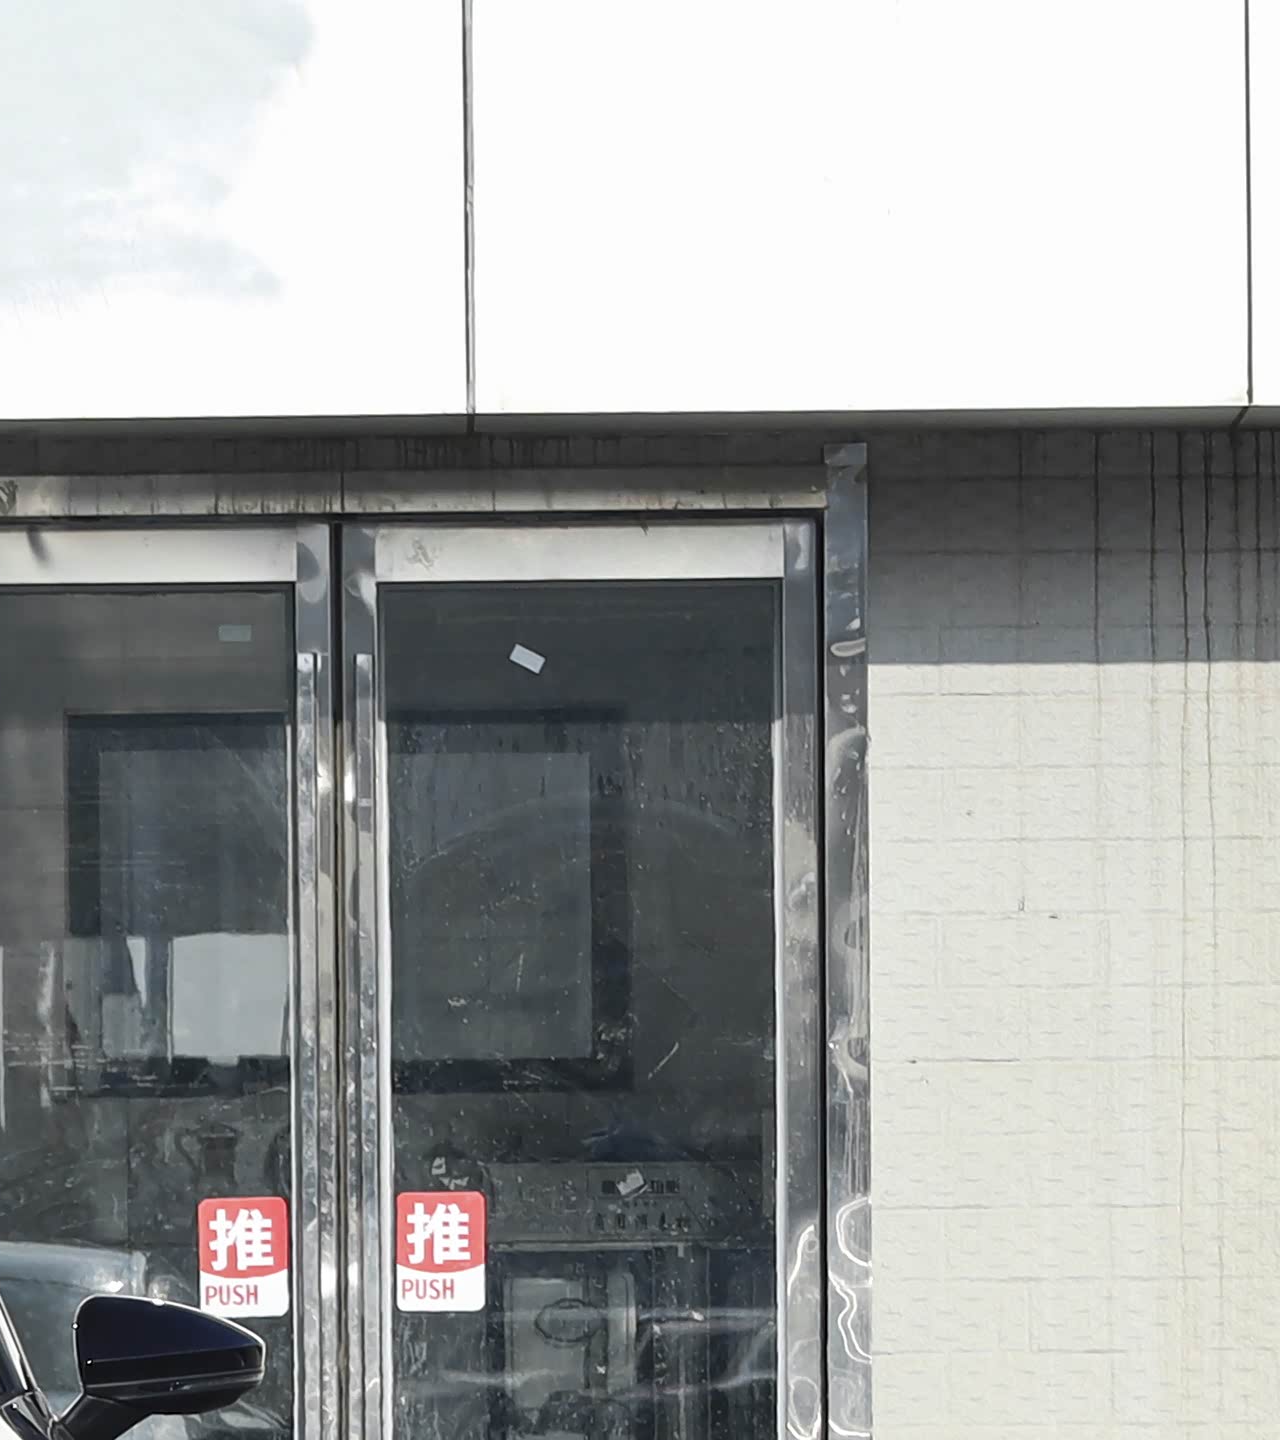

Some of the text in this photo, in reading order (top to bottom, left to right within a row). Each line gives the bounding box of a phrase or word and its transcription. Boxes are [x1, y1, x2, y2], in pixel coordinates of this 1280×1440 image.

[208, 1208, 274, 1271] 推
[407, 1203, 471, 1264] 推
[205, 1285, 259, 1305] PUSH
[401, 1279, 454, 1299] PUSH
